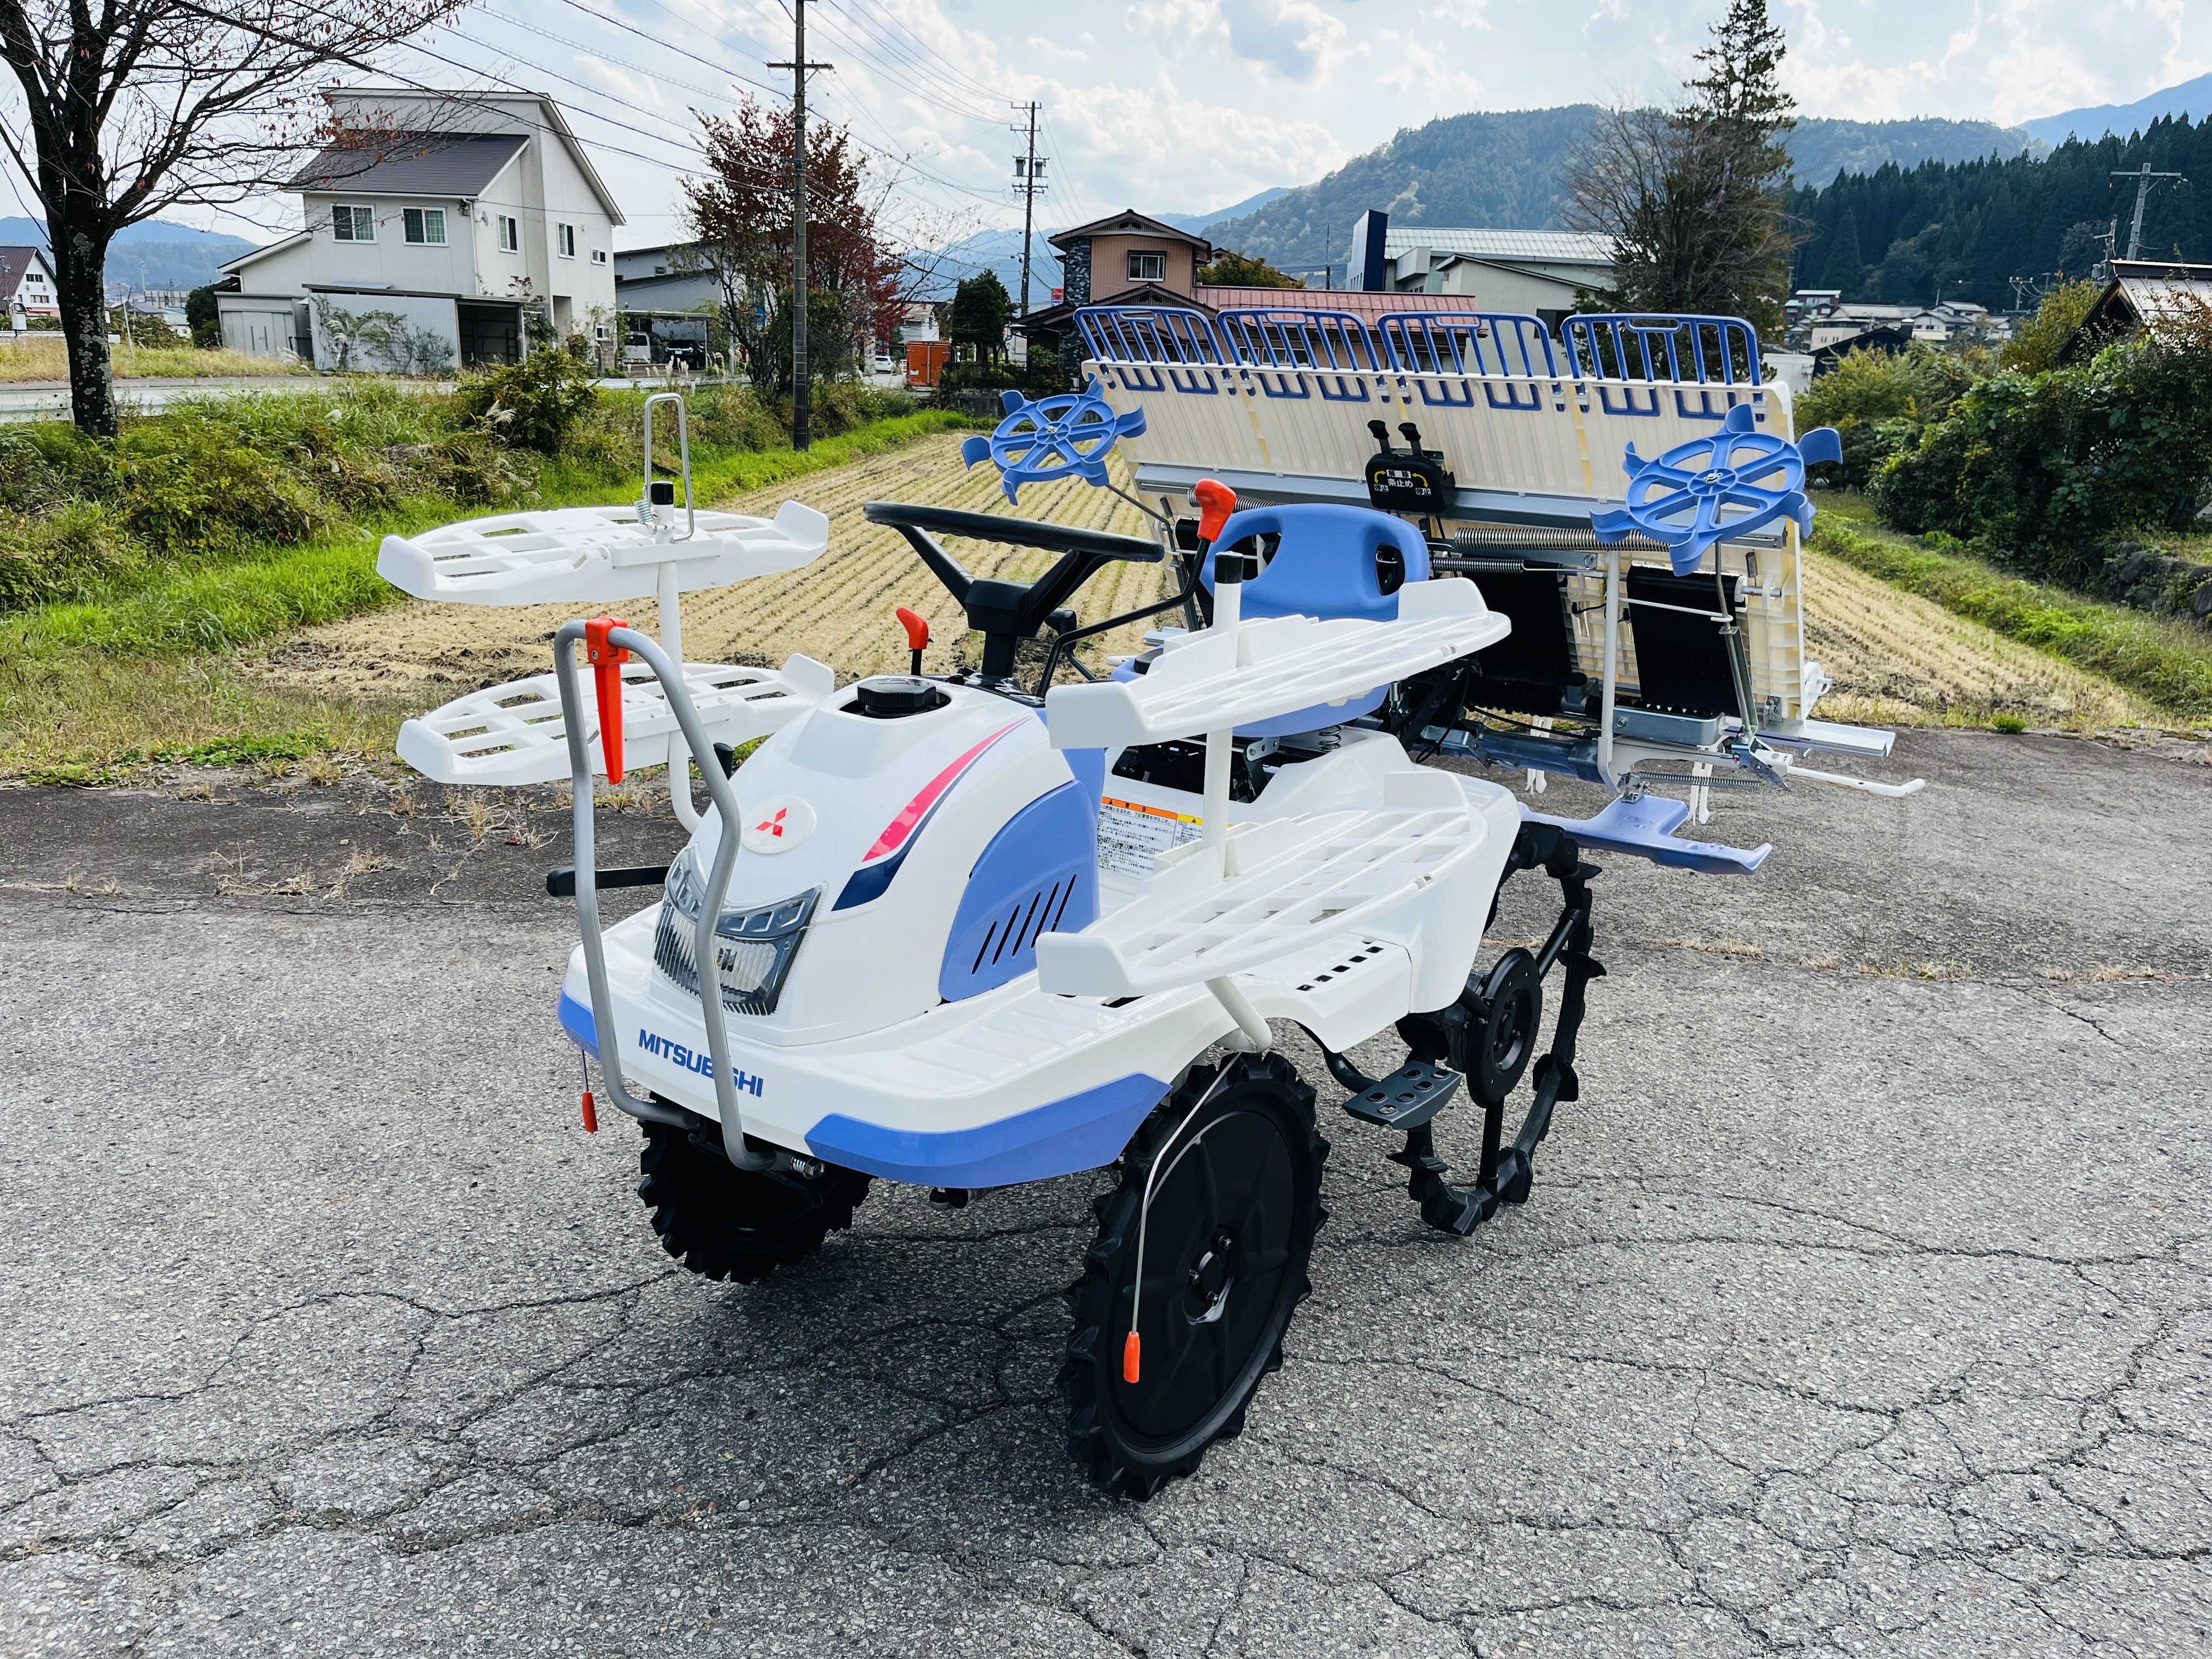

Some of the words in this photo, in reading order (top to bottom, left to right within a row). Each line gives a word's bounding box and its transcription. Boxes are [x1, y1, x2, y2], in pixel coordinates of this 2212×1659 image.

[1388, 470, 1410, 478] 解除
[1387, 478, 1413, 487] 条止め
[639, 1029, 763, 1097] MITSUBHI
